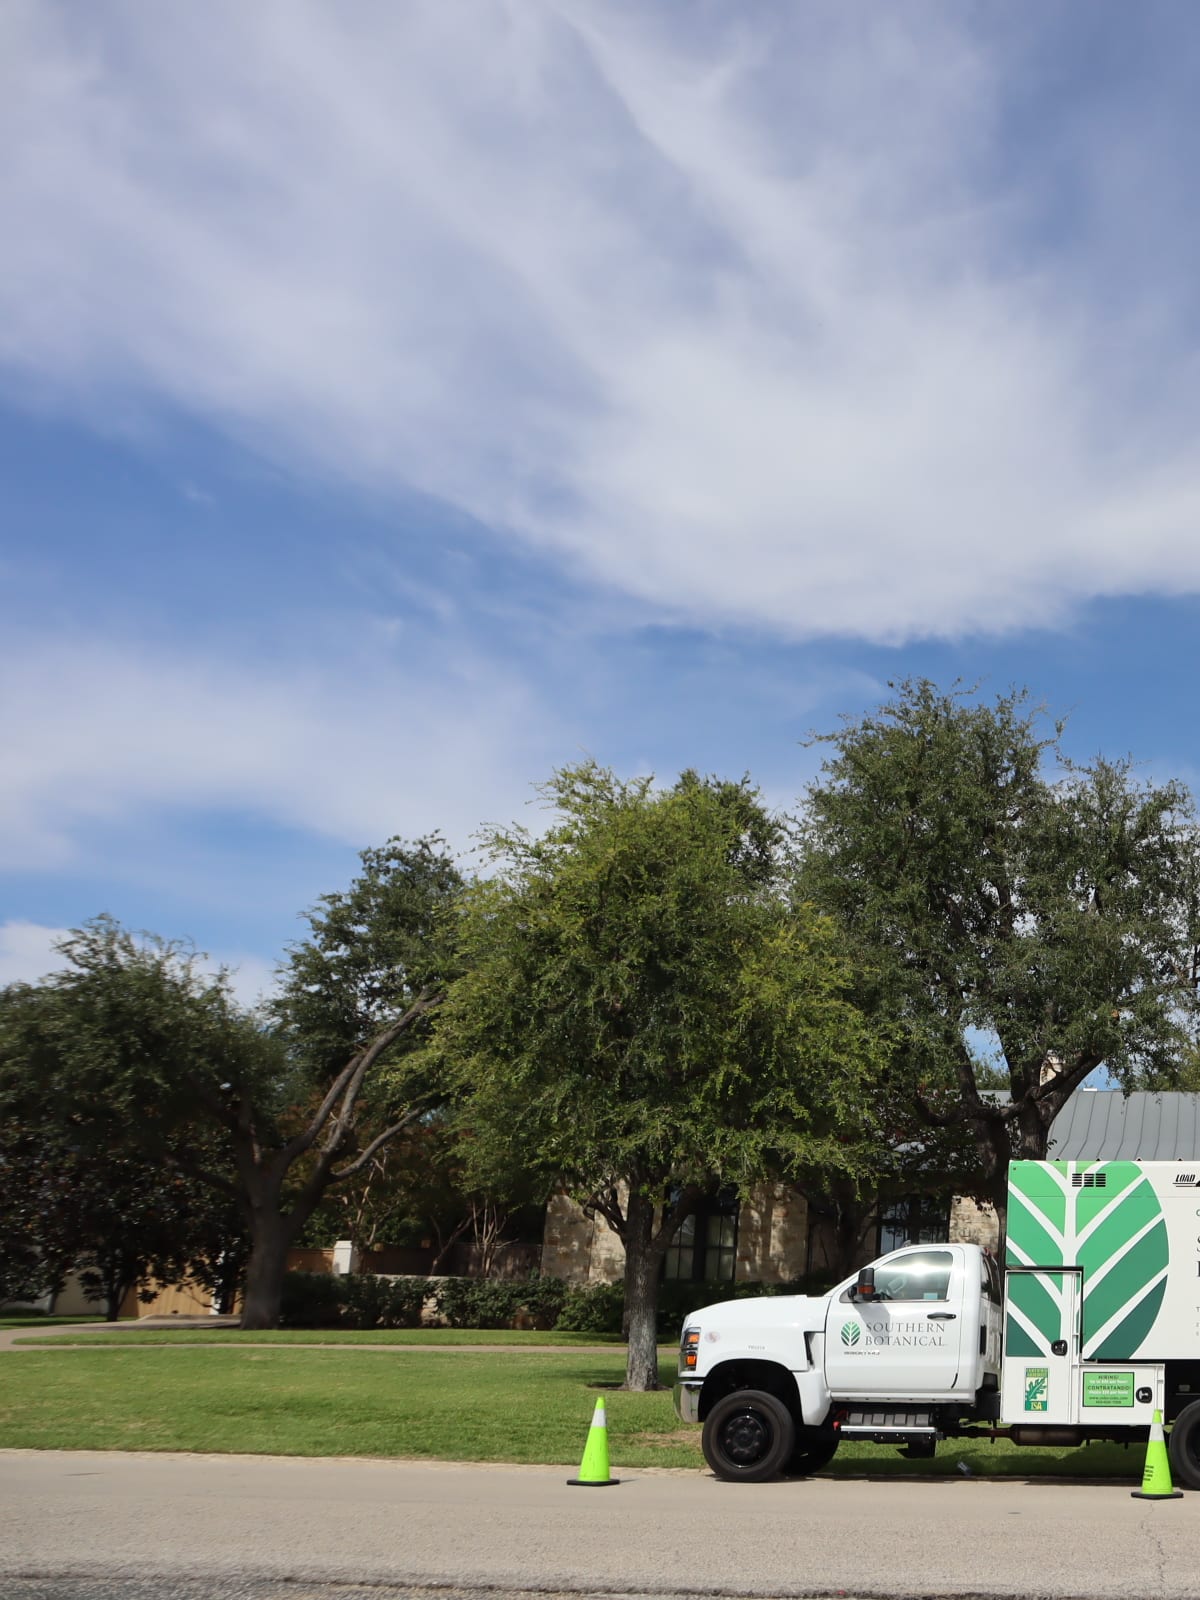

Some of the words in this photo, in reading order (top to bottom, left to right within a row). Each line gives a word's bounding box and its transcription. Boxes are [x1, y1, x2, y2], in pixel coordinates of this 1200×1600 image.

[1175, 1174, 1196, 1182] LOAD
[865, 1322, 945, 1333] SOUTHERN
[865, 1336, 945, 1346] BOTANICAL
